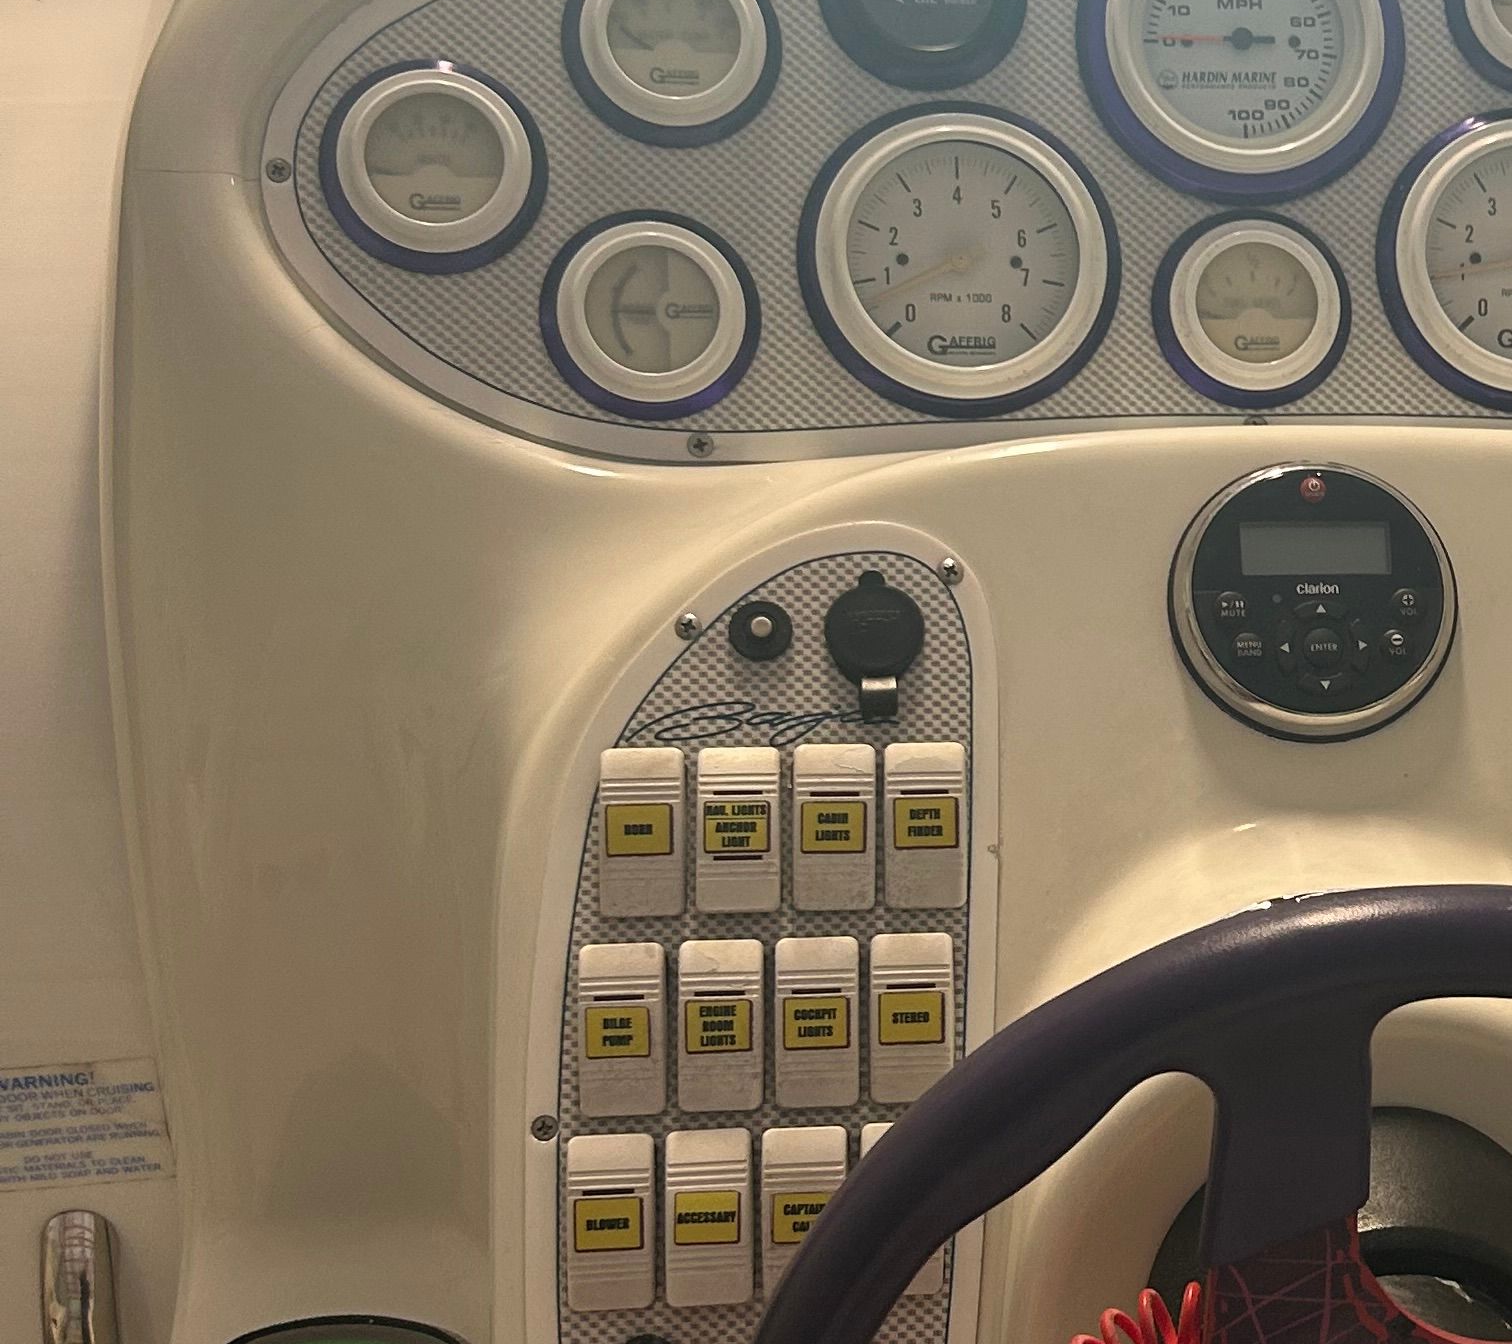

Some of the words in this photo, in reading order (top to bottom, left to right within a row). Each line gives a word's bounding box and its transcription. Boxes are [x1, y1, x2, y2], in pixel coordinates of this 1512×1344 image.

[1168, 5, 1191, 16] 10
[1216, 0, 1263, 11] MPH
[1290, 16, 1316, 28] 60
[1295, 49, 1320, 60] 70
[1181, 71, 1227, 84] HARDIN
[1230, 71, 1277, 84] MARINE
[1264, 99, 1290, 110] 90
[1227, 109, 1265, 121] 100
[952, 185, 962, 204] 4
[912, 198, 922, 217] 3
[991, 199, 1001, 219] 5
[1488, 198, 1497, 216] 3
[888, 226, 898, 246] 2
[1017, 229, 1027, 248] 6
[1465, 224, 1474, 243] 2
[884, 267, 890, 285] 1
[1020, 268, 1030, 287] 7
[930, 293, 952, 303] RPM
[905, 304, 916, 322] 0
[1001, 304, 1011, 323] 8
[1478, 298, 1488, 317] 0
[1296, 582, 1340, 595] clarion
[1220, 608, 1246, 618] MUTE
[1310, 642, 1338, 652] ENTER
[909, 808, 941, 820] DEPTH
[794, 1007, 838, 1021] COCKPIT
[892, 1011, 930, 1024] STEREO
[87, 1082, 155, 1096] CRUISING
[586, 1217, 630, 1232] BLOWER
